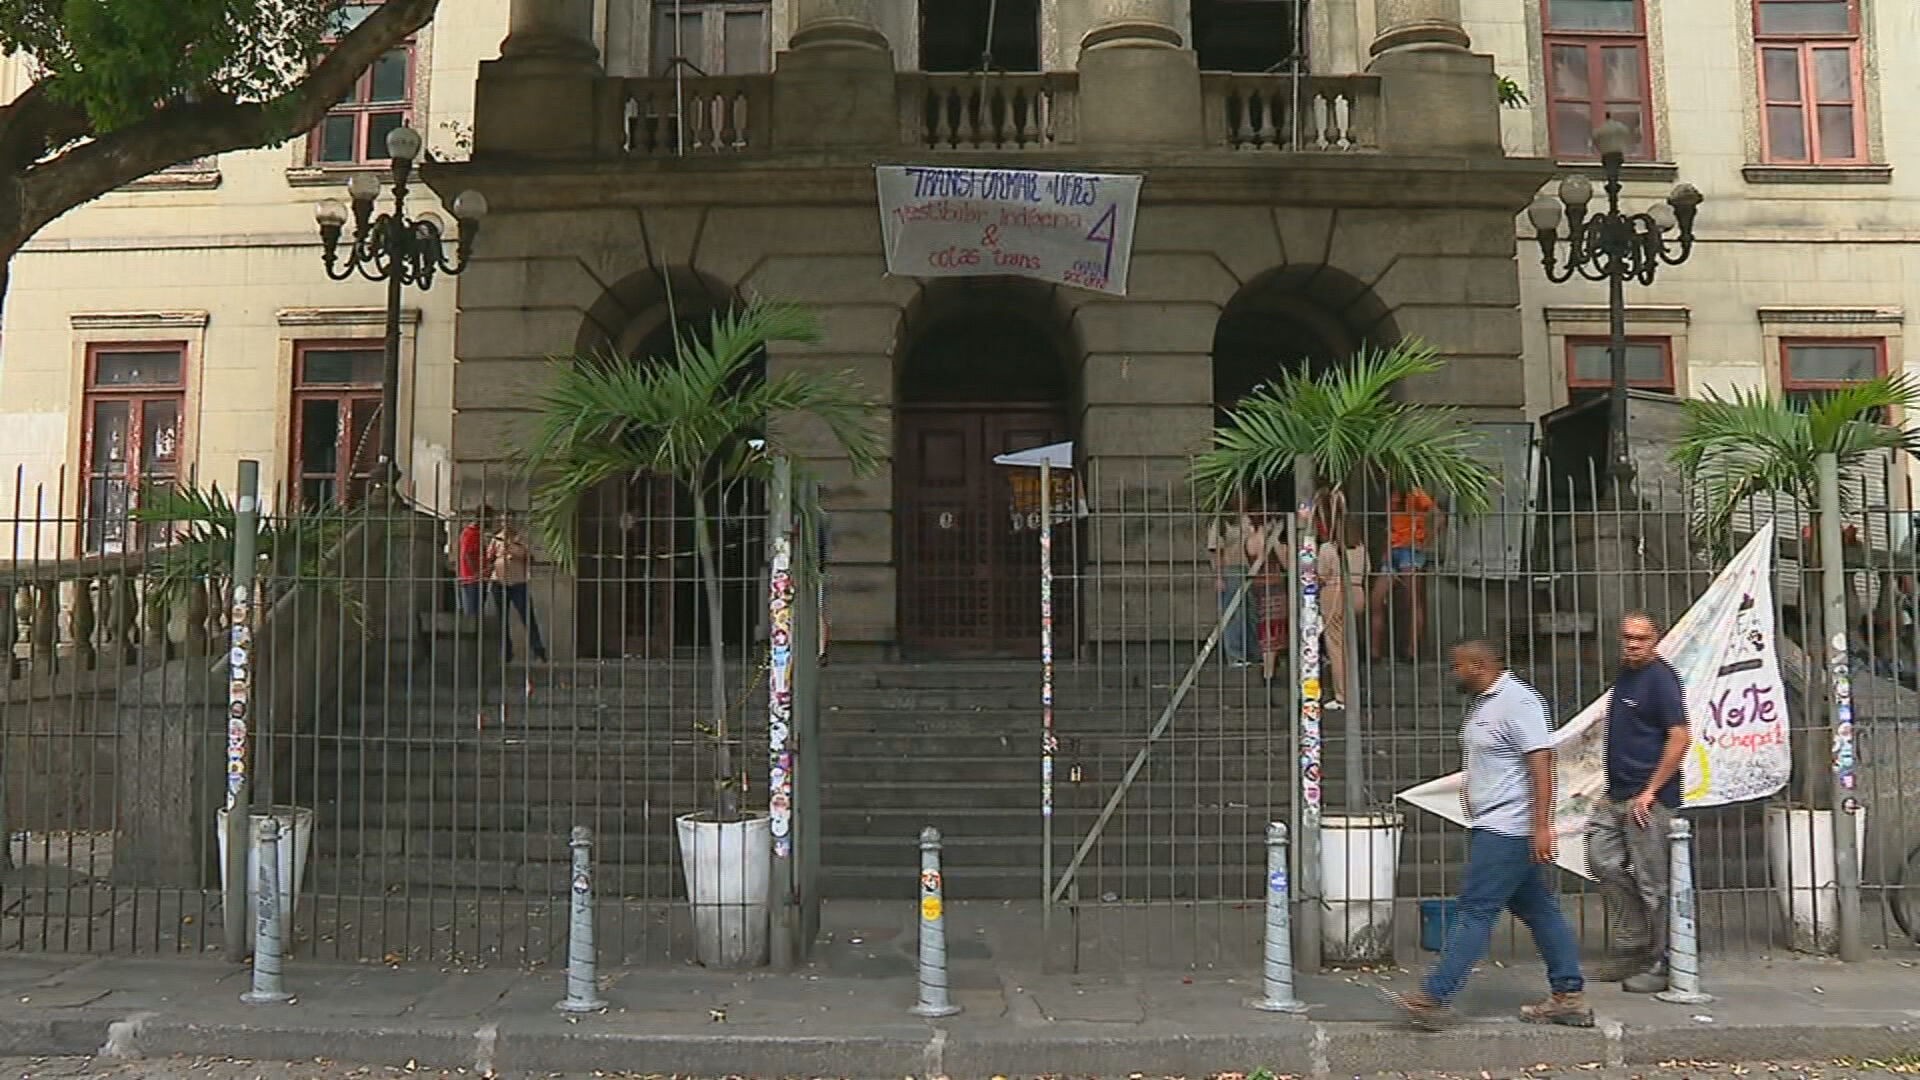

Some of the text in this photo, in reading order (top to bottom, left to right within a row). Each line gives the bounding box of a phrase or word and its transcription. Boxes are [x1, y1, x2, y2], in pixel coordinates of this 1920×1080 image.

[1054, 174, 1100, 206] UFRJ
[981, 223, 999, 247] &
[993, 249, 1041, 270] trans
